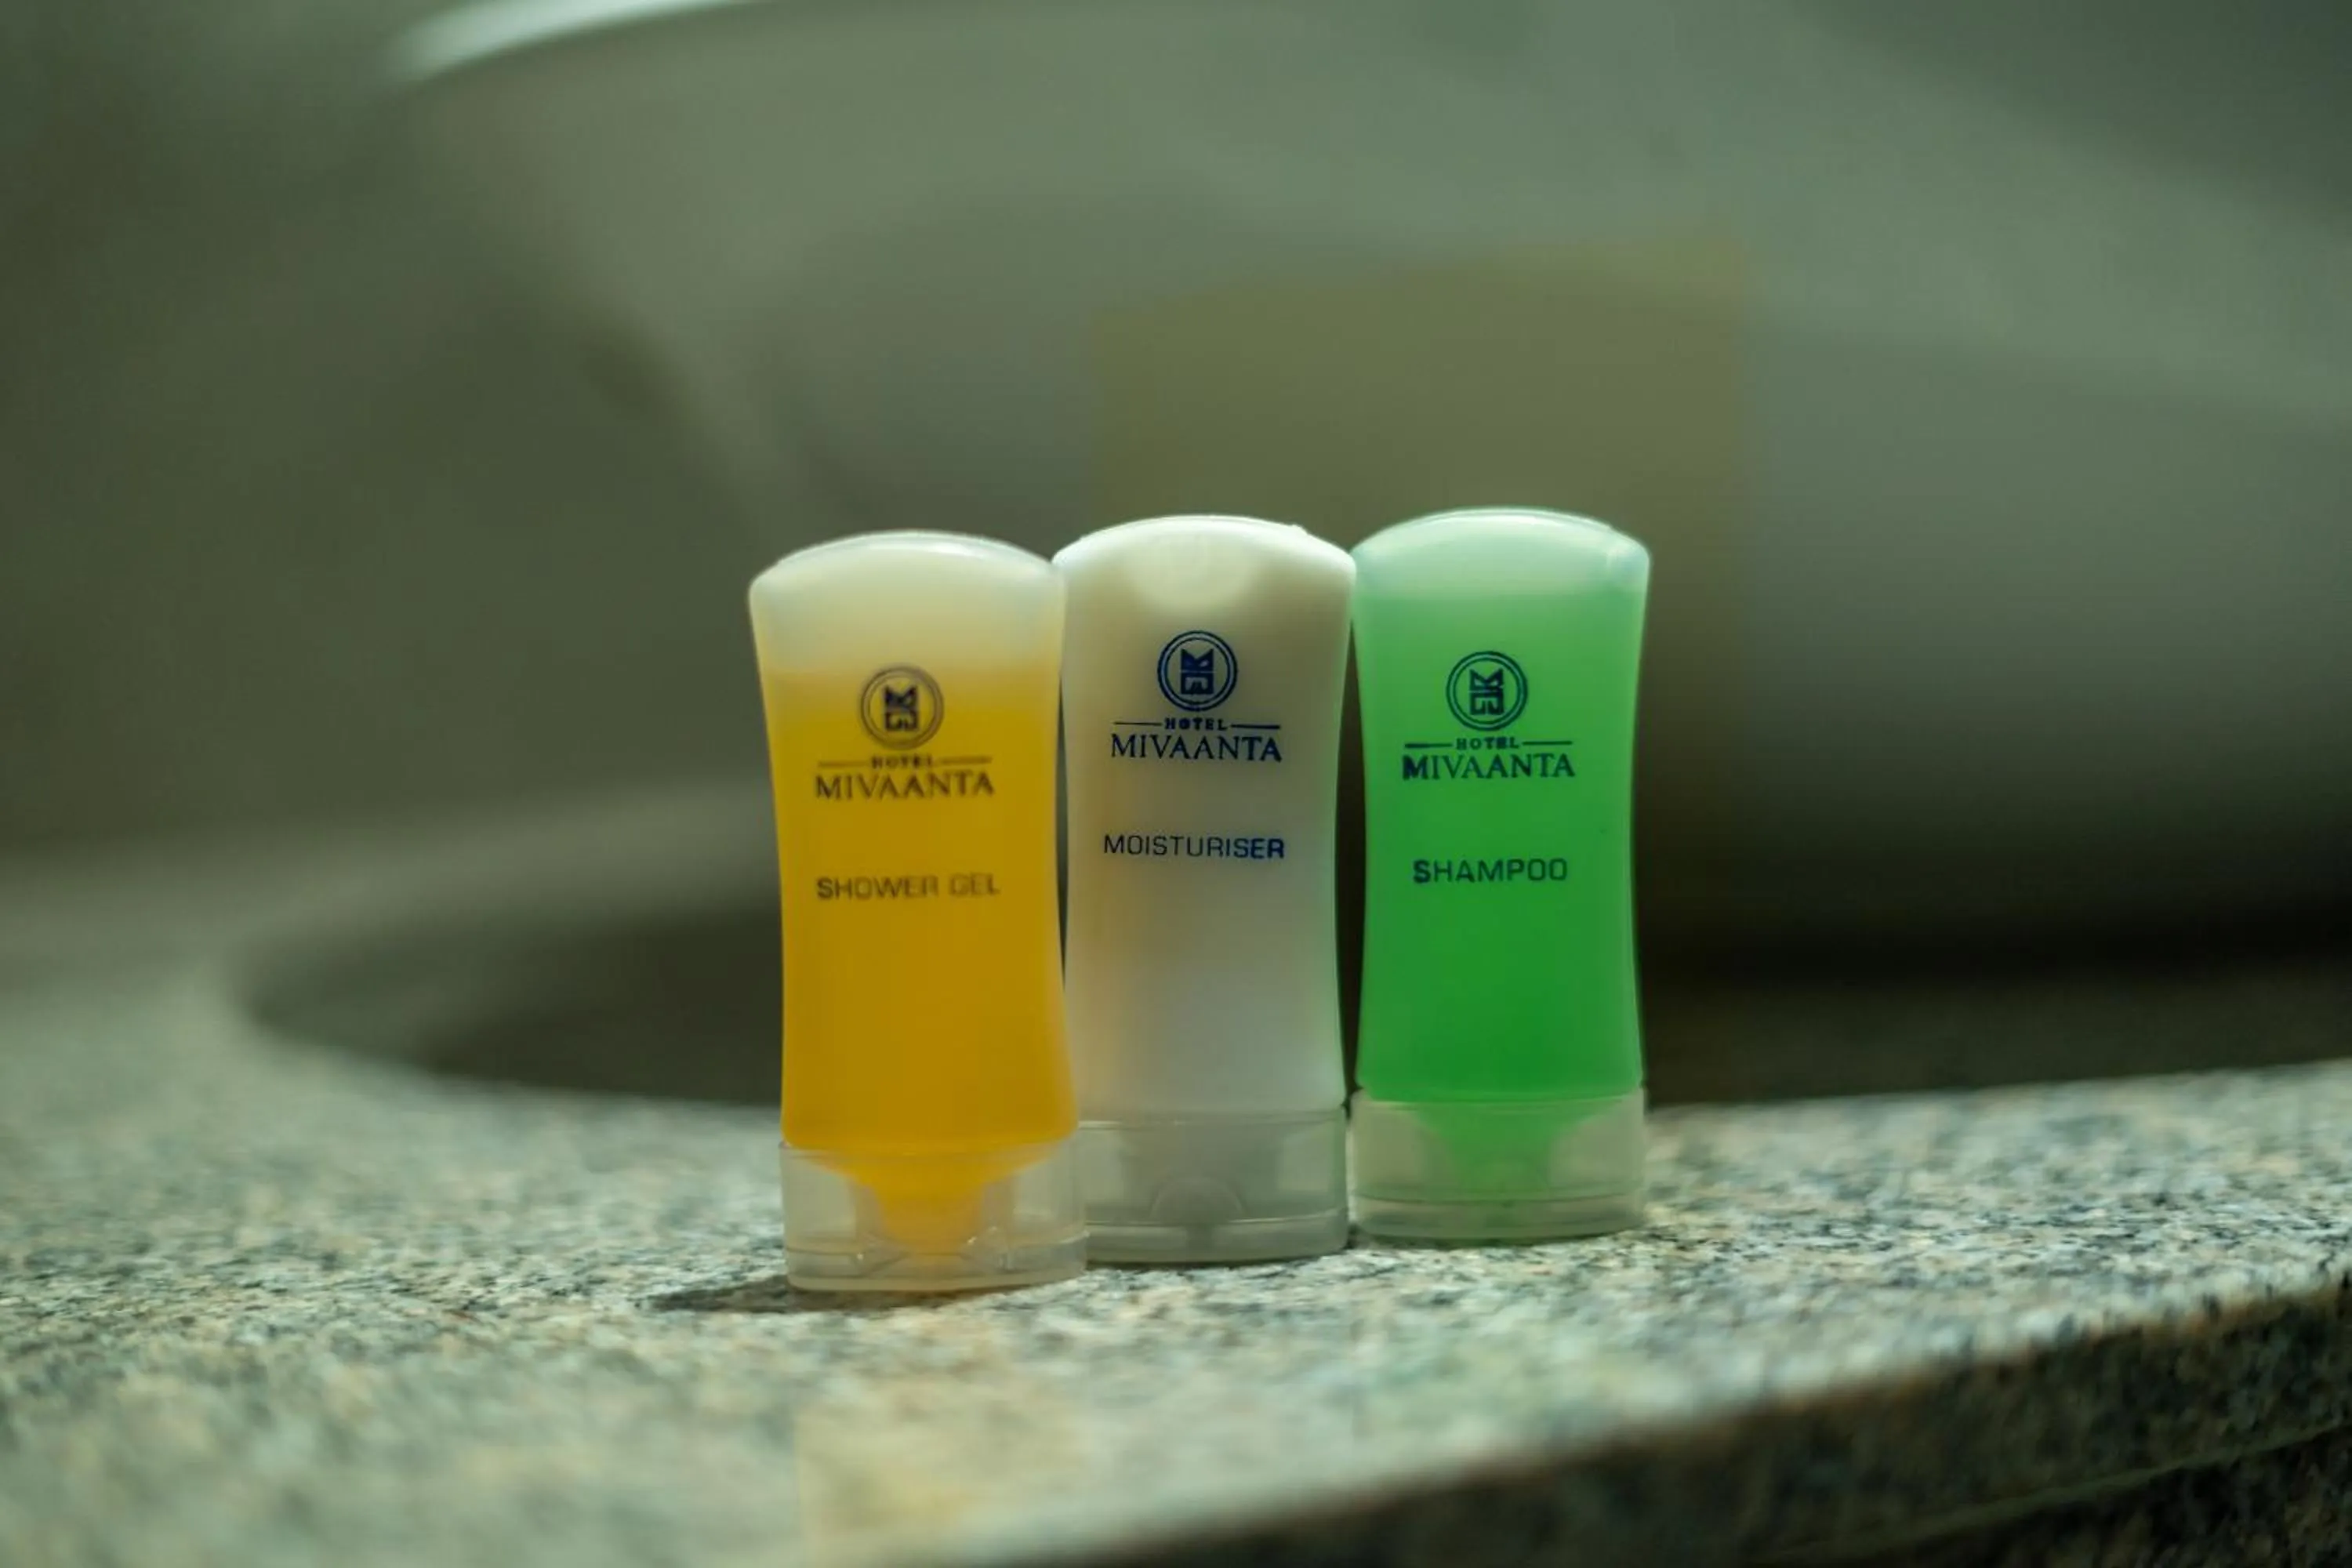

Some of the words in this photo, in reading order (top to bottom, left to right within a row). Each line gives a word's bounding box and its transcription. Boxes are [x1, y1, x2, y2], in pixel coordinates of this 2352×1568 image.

[1164, 717, 1228, 731] HOTEL
[1111, 733, 1283, 762] MIVAANTA
[1456, 736, 1519, 750] HOTEL
[1402, 753, 1575, 780] MIVAANTA
[815, 768, 995, 800] MIVAANTA
[1103, 834, 1284, 859] MOISTURISER
[1413, 858, 1567, 884] SHAMPOO
[816, 876, 938, 899] SHOWER
[949, 873, 1000, 897] GEL
